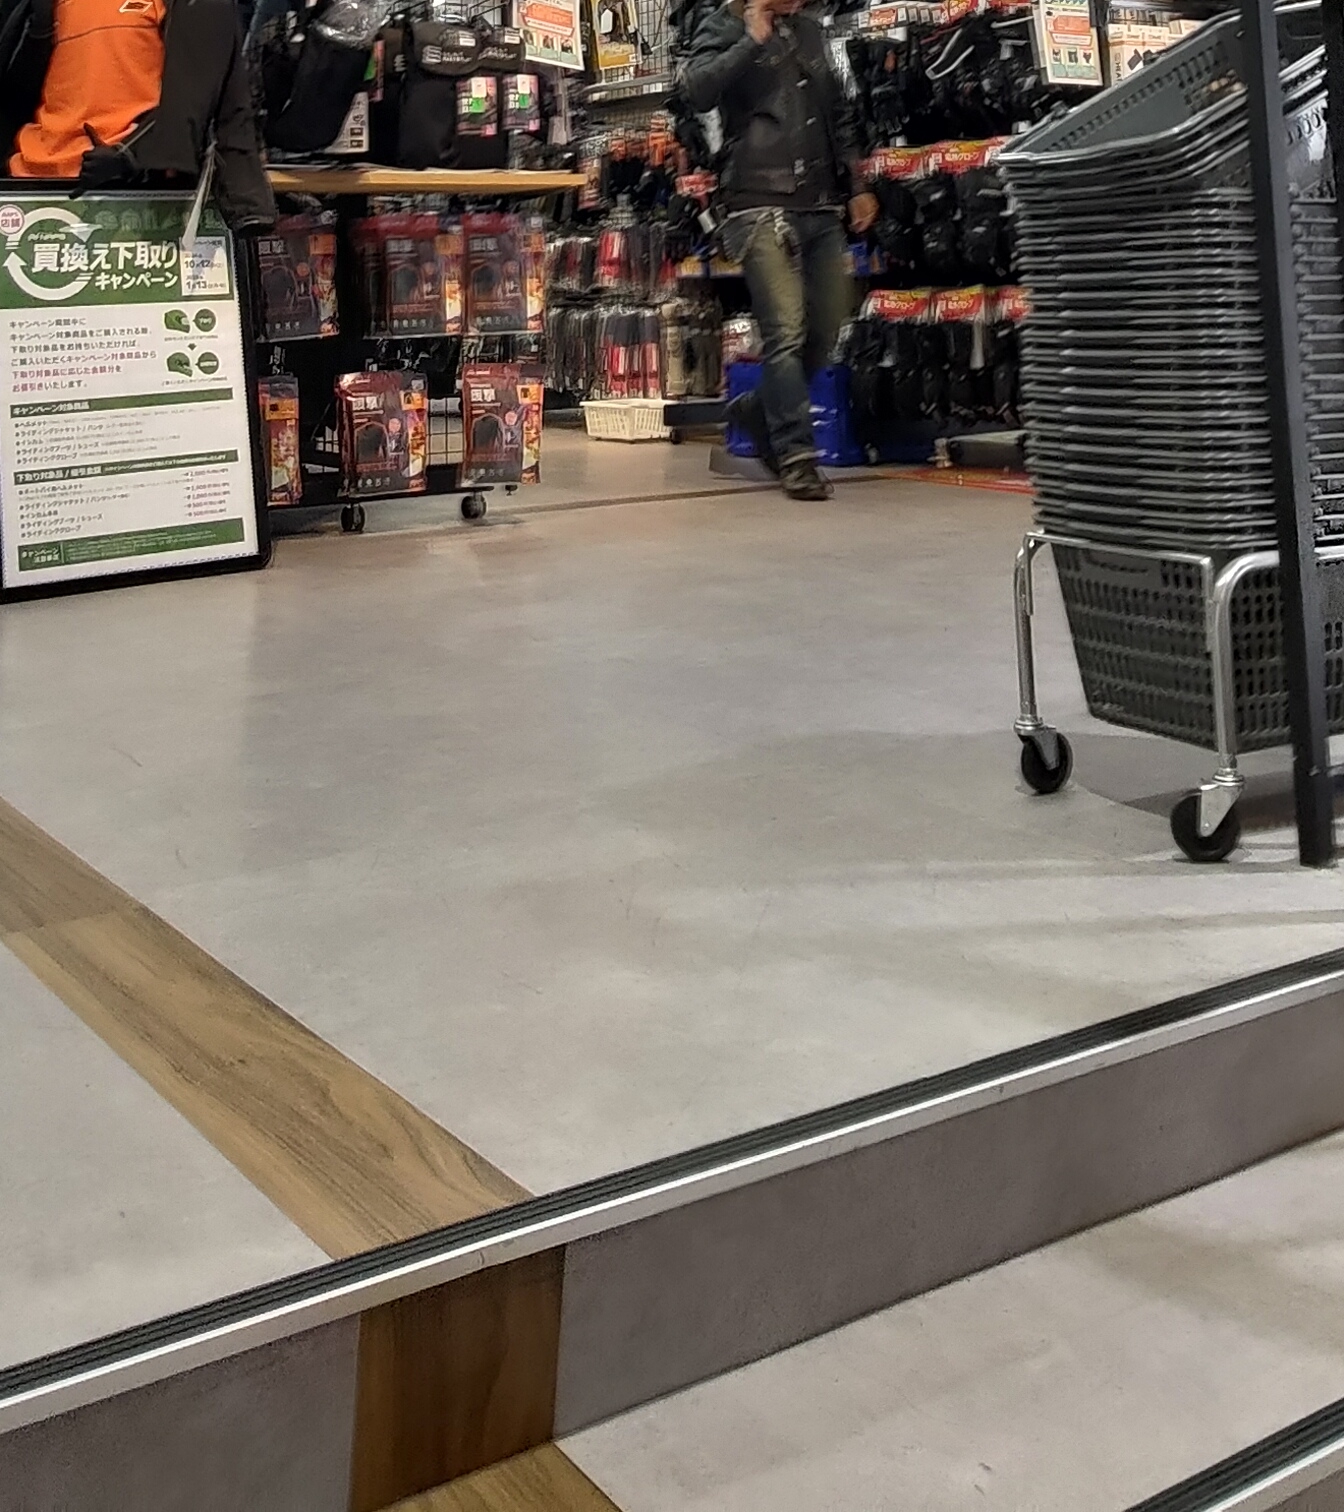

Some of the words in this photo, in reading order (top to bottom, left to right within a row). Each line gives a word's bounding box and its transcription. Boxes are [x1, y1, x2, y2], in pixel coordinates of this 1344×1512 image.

[31, 240, 179, 274] 買換え下取り
[94, 272, 179, 291] キャンペーン
